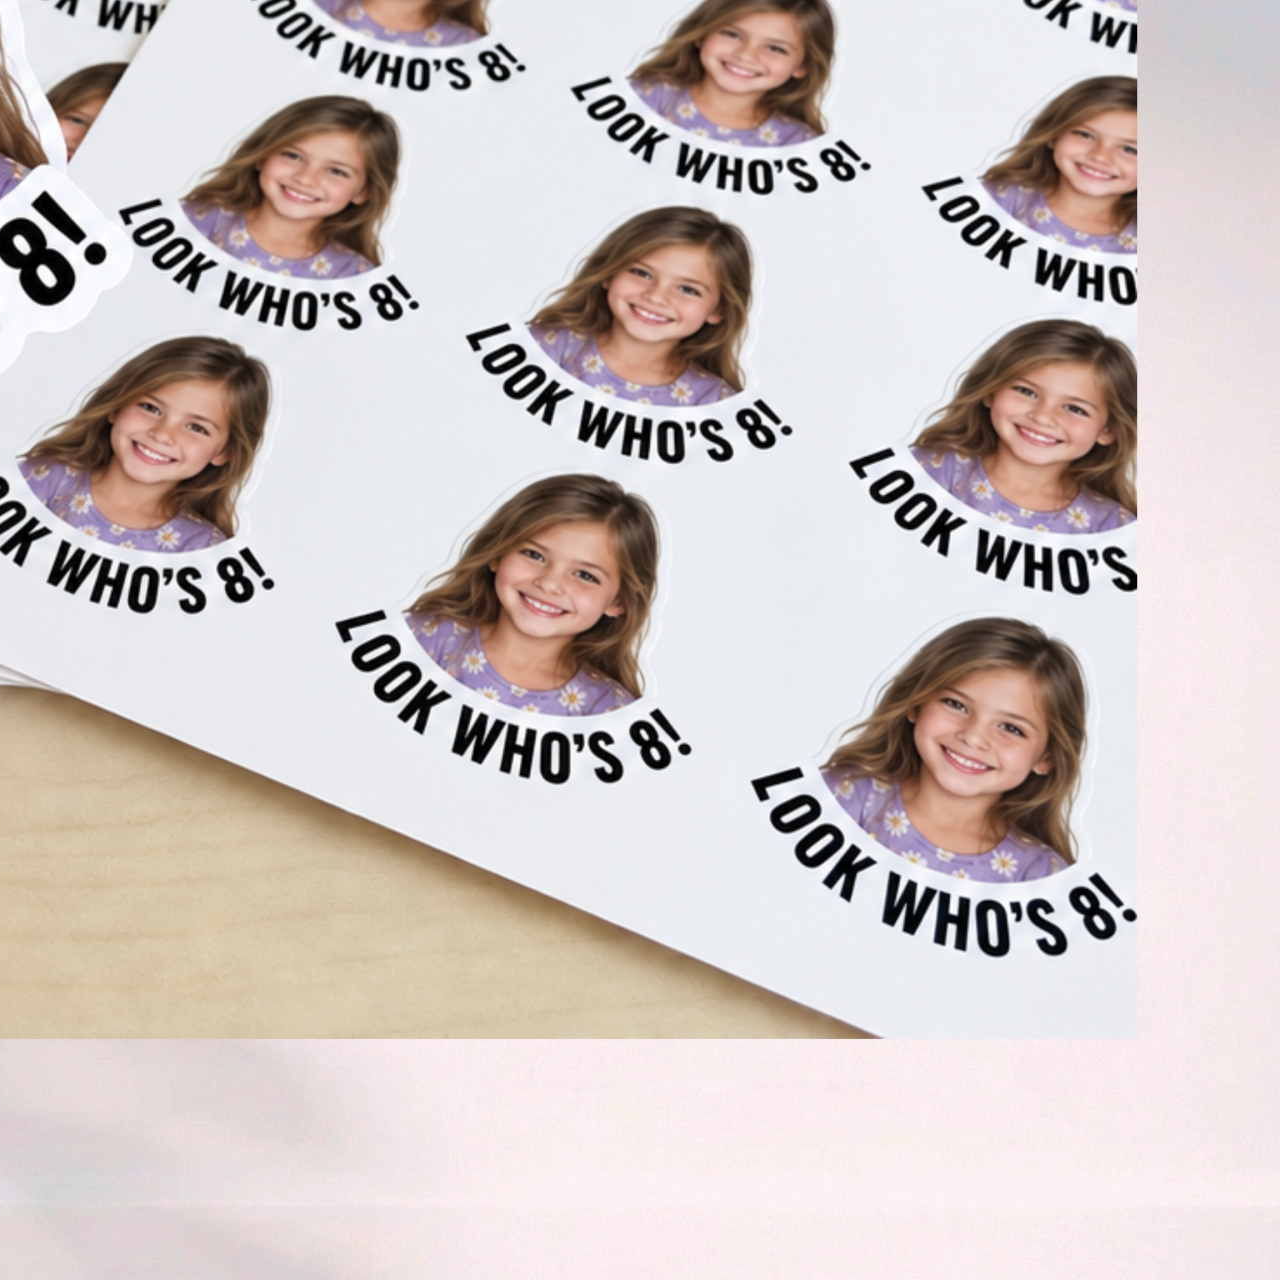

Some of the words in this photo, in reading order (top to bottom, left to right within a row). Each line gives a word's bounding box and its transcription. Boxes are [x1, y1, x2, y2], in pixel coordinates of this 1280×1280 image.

[340, 42, 471, 91] WHO’S
[479, 44, 525, 81] 8!
[572, 77, 669, 163] LOOK
[677, 143, 818, 195] WHO’S
[820, 141, 870, 181] 8!
[119, 199, 217, 292] LOOK
[220, 271, 361, 330] WHO’S
[370, 275, 419, 320] 8!
[923, 177, 1026, 268] LOOK
[466, 324, 573, 425] LOOK
[578, 401, 733, 463] WHO’S
[736, 400, 792, 449] 8!
[47, 540, 206, 614] WHO’S
[217, 548, 274, 603] 8!
[850, 448, 966, 556] LOOK
[976, 529, 1137, 594] WHO’S
[336, 610, 451, 734] LOOK
[452, 705, 623, 784] WHO’S
[630, 709, 691, 770] 8!
[752, 767, 876, 902] LOOK
[883, 872, 1067, 957] WHO’S
[1069, 874, 1137, 939] 8!
